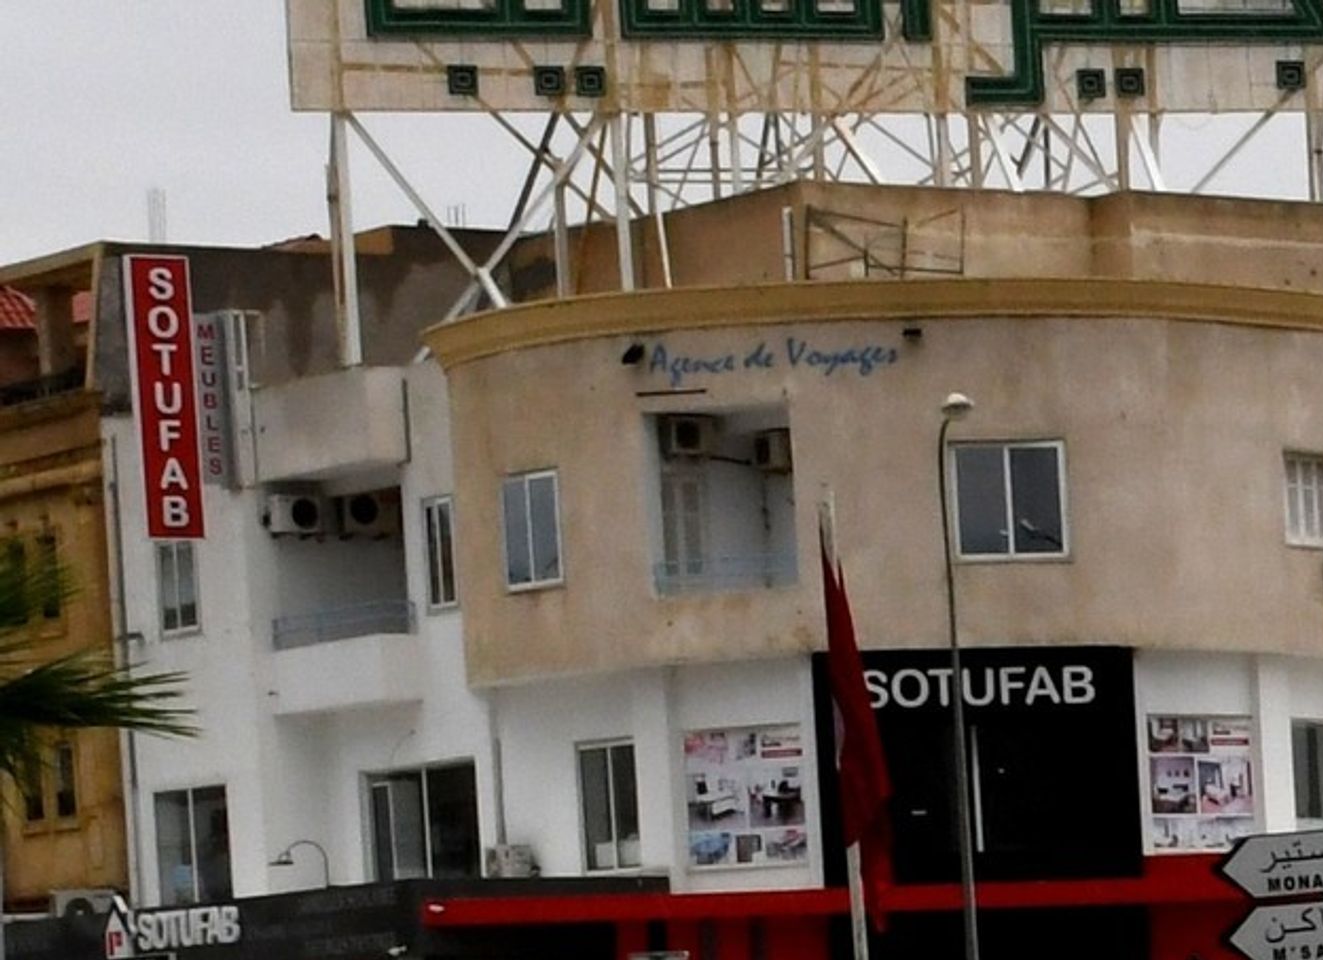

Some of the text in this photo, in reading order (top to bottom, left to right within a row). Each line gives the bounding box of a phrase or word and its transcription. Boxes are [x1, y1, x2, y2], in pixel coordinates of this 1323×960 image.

[650, 337, 898, 385] Agence de Voyages
[148, 267, 190, 528] SOTUFAB
[197, 323, 222, 476] MEUBLES
[862, 664, 1096, 709] SOTUFAB
[137, 905, 241, 950] SOTUFAB
